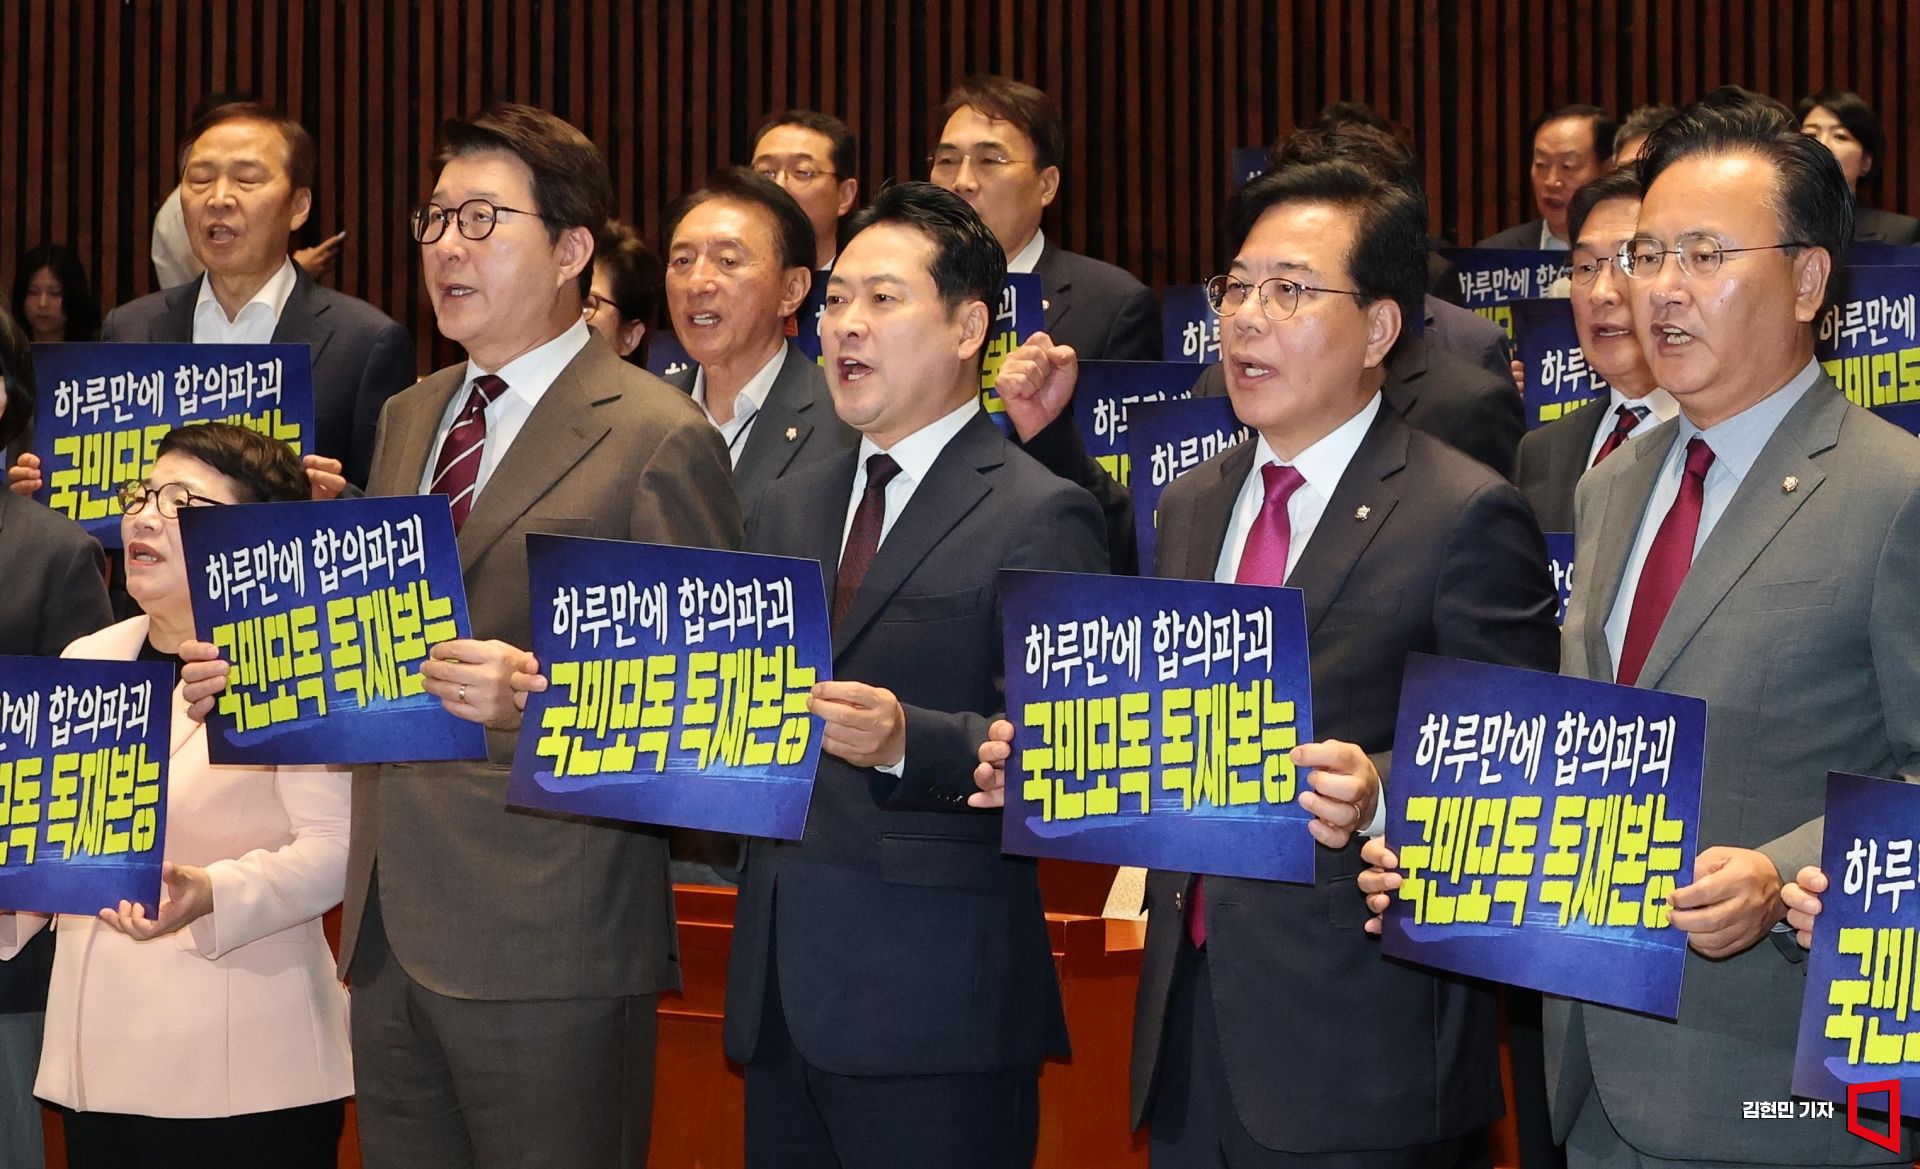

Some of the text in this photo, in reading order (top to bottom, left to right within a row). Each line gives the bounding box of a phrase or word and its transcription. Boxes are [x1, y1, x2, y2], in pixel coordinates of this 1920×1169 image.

[54, 357, 283, 427] 하루만에 합의파괴
[205, 513, 426, 612] 하루만에 합의파괴
[552, 577, 795, 649] 하루만에 합의파괴
[1025, 606, 1273, 690] 하루만에 합의파괴
[48, 679, 152, 748] 합의파괴
[212, 605, 327, 733] 국민모독
[536, 644, 816, 778] 국민모독 독재본능
[1021, 678, 1297, 823] 국민모독 독재본능
[1414, 710, 1676, 788] 하루만에 합의파괴
[47, 742, 160, 861] 독재본능
[1398, 794, 1684, 929] 국민모독 독재본능
